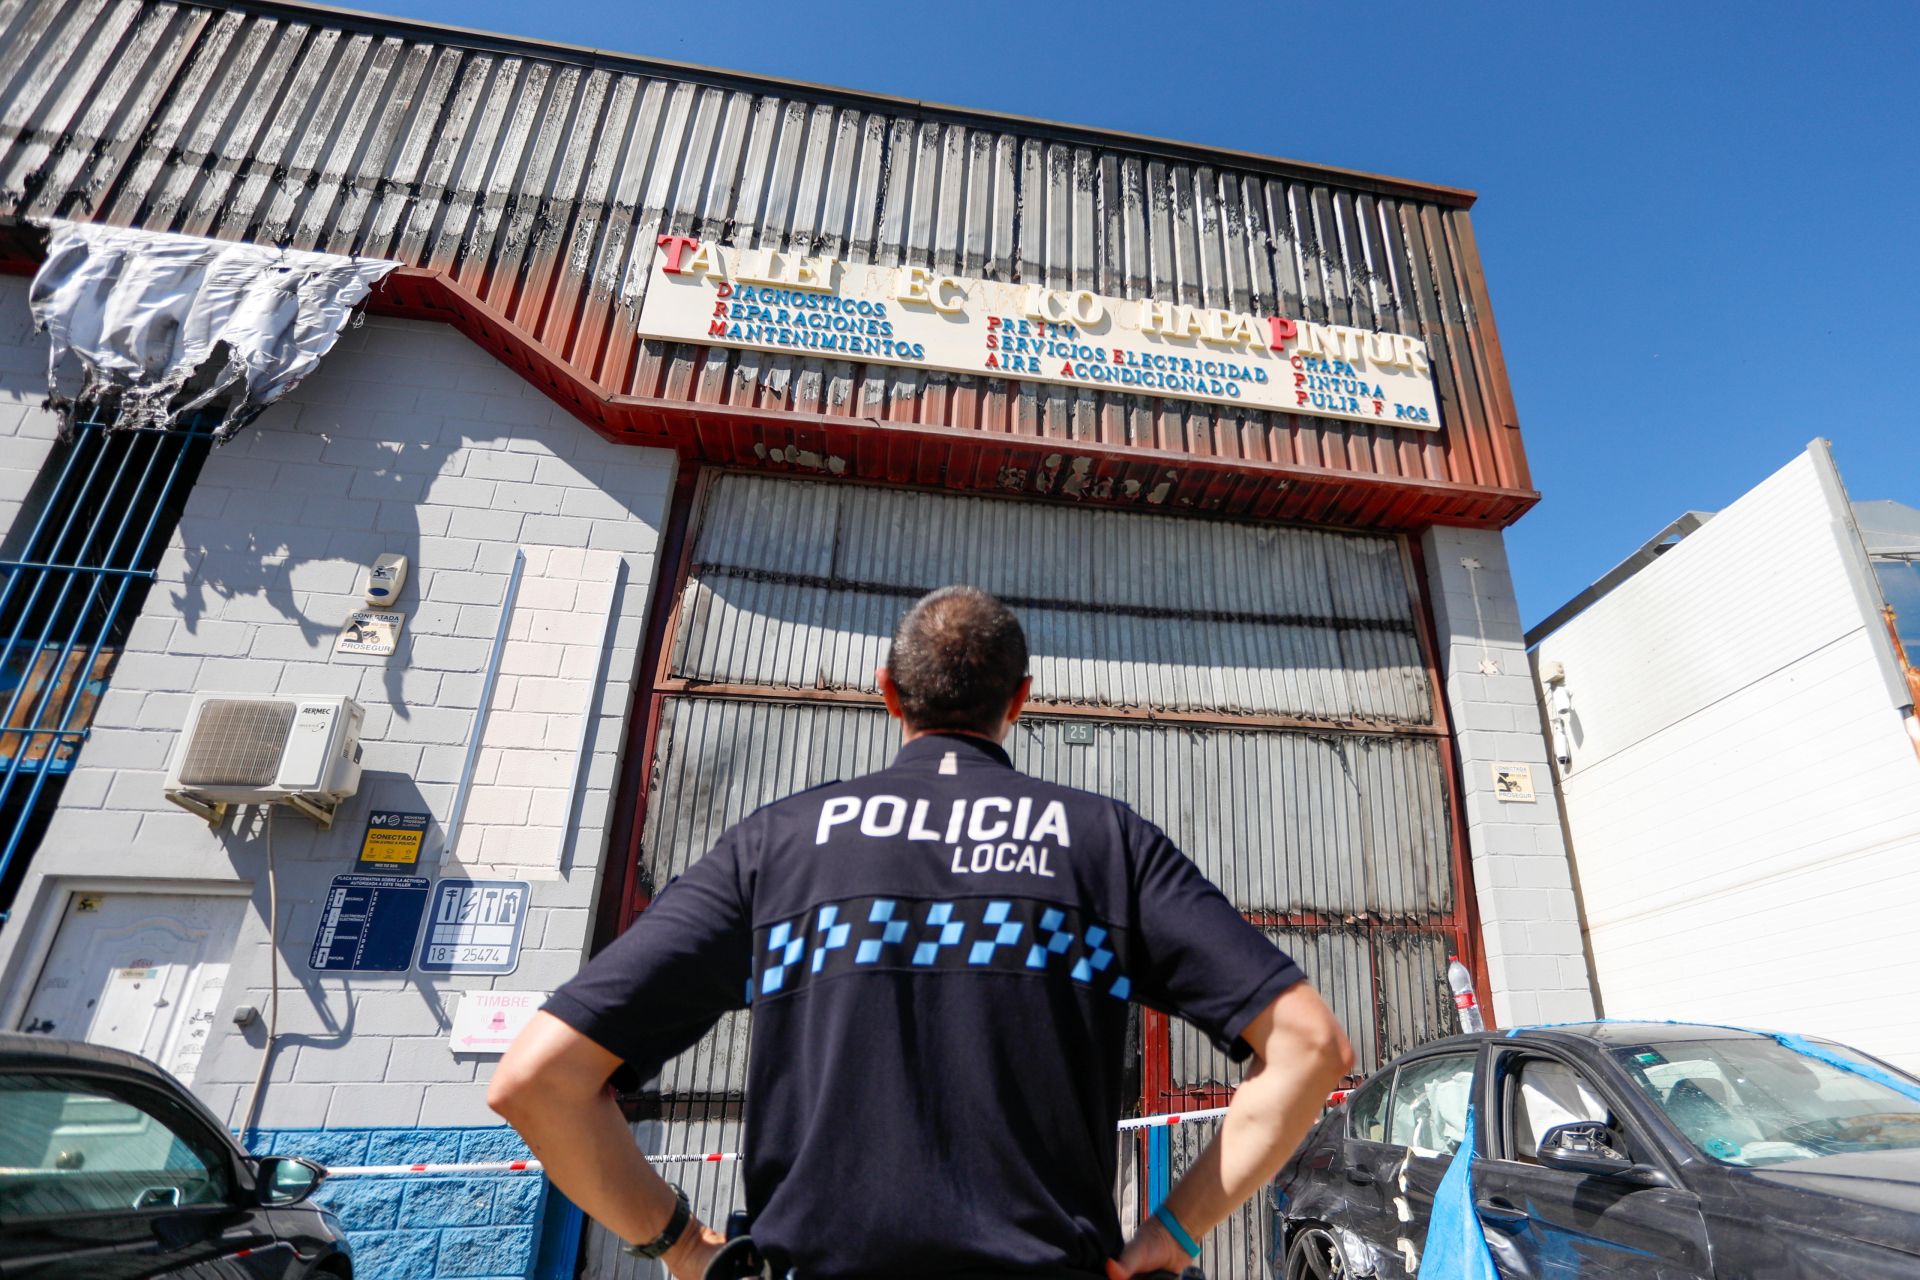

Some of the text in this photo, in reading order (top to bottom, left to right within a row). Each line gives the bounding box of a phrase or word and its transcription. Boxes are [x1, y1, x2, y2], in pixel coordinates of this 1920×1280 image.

[716, 282, 887, 317] DIAGNOSTICOS
[713, 301, 893, 336] REPARACIONES
[987, 316, 1076, 340] PRE ITV
[708, 319, 926, 359] MANTENIMIENTOS
[986, 334, 1268, 383] SERVICIOS ELECTRICIDAD
[1290, 355, 1357, 378] CHAPA
[985, 353, 1240, 398] AIRE ACONDICIONADO
[1293, 372, 1385, 399] PINTURA
[1296, 390, 1360, 412] PULIR
[352, 612, 399, 621] CONECTADA
[341, 643, 392, 652] PROSEGUR
[1070, 725, 1087, 740] 25
[816, 795, 1070, 847] POLICIA
[370, 833, 417, 841] CONECTADA
[951, 843, 1055, 877] LOCAL
[431, 947, 446, 961] 18
[461, 948, 500, 962] 25474
[476, 995, 529, 1008] TIMBRE
